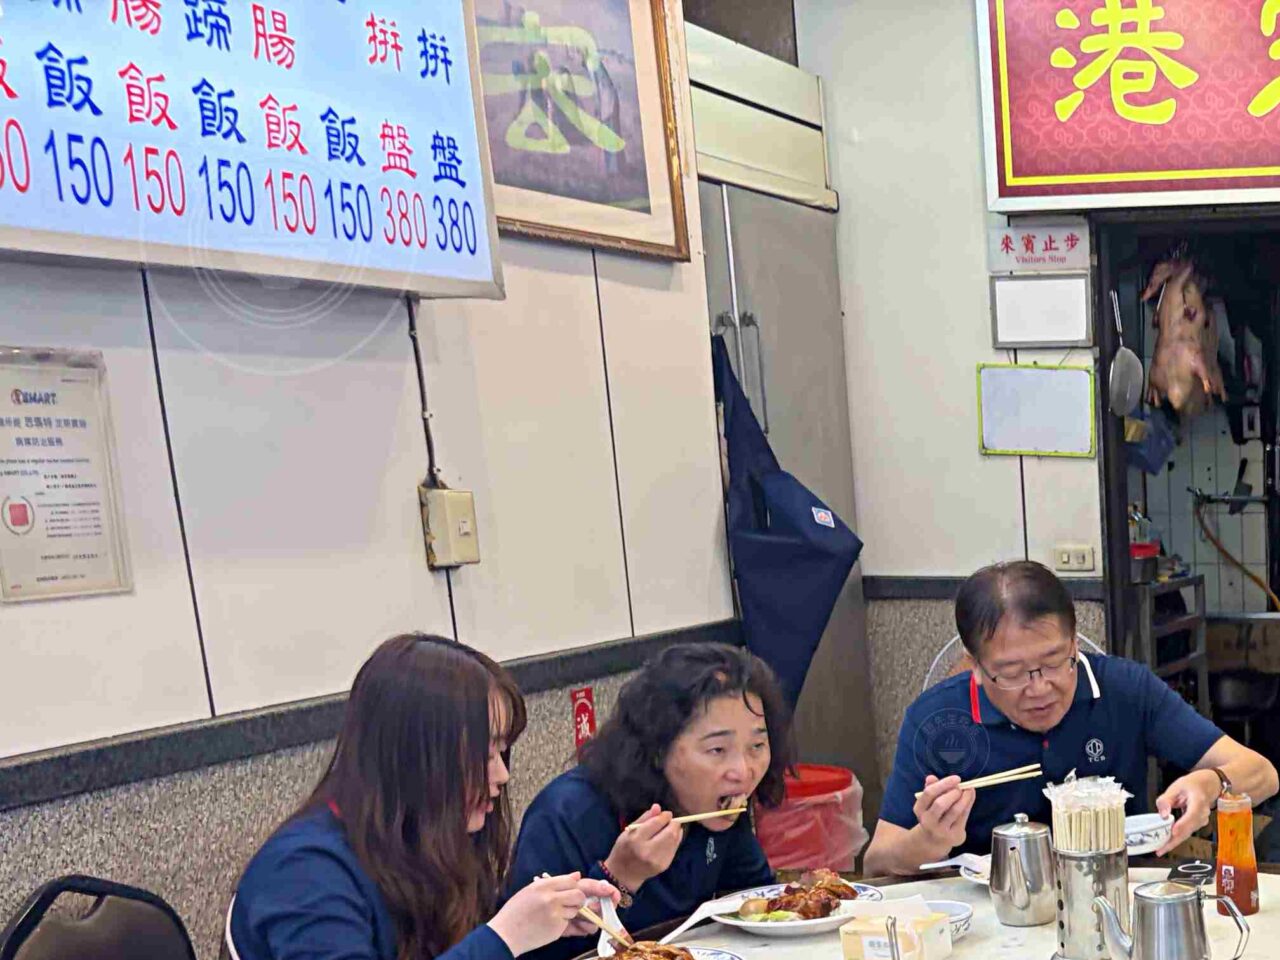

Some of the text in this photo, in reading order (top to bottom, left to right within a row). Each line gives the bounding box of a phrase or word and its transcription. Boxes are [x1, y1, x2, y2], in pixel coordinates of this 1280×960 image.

[44, 129, 114, 208] 150
[123, 142, 187, 217] 150
[198, 155, 255, 226] 150
[264, 168, 317, 236] 150
[324, 178, 373, 243] 150
[380, 186, 428, 250] 380
[432, 194, 477, 256] 380
[1000, 232, 1081, 255] 來賓止步
[1015, 255, 1047, 264] Visitors
